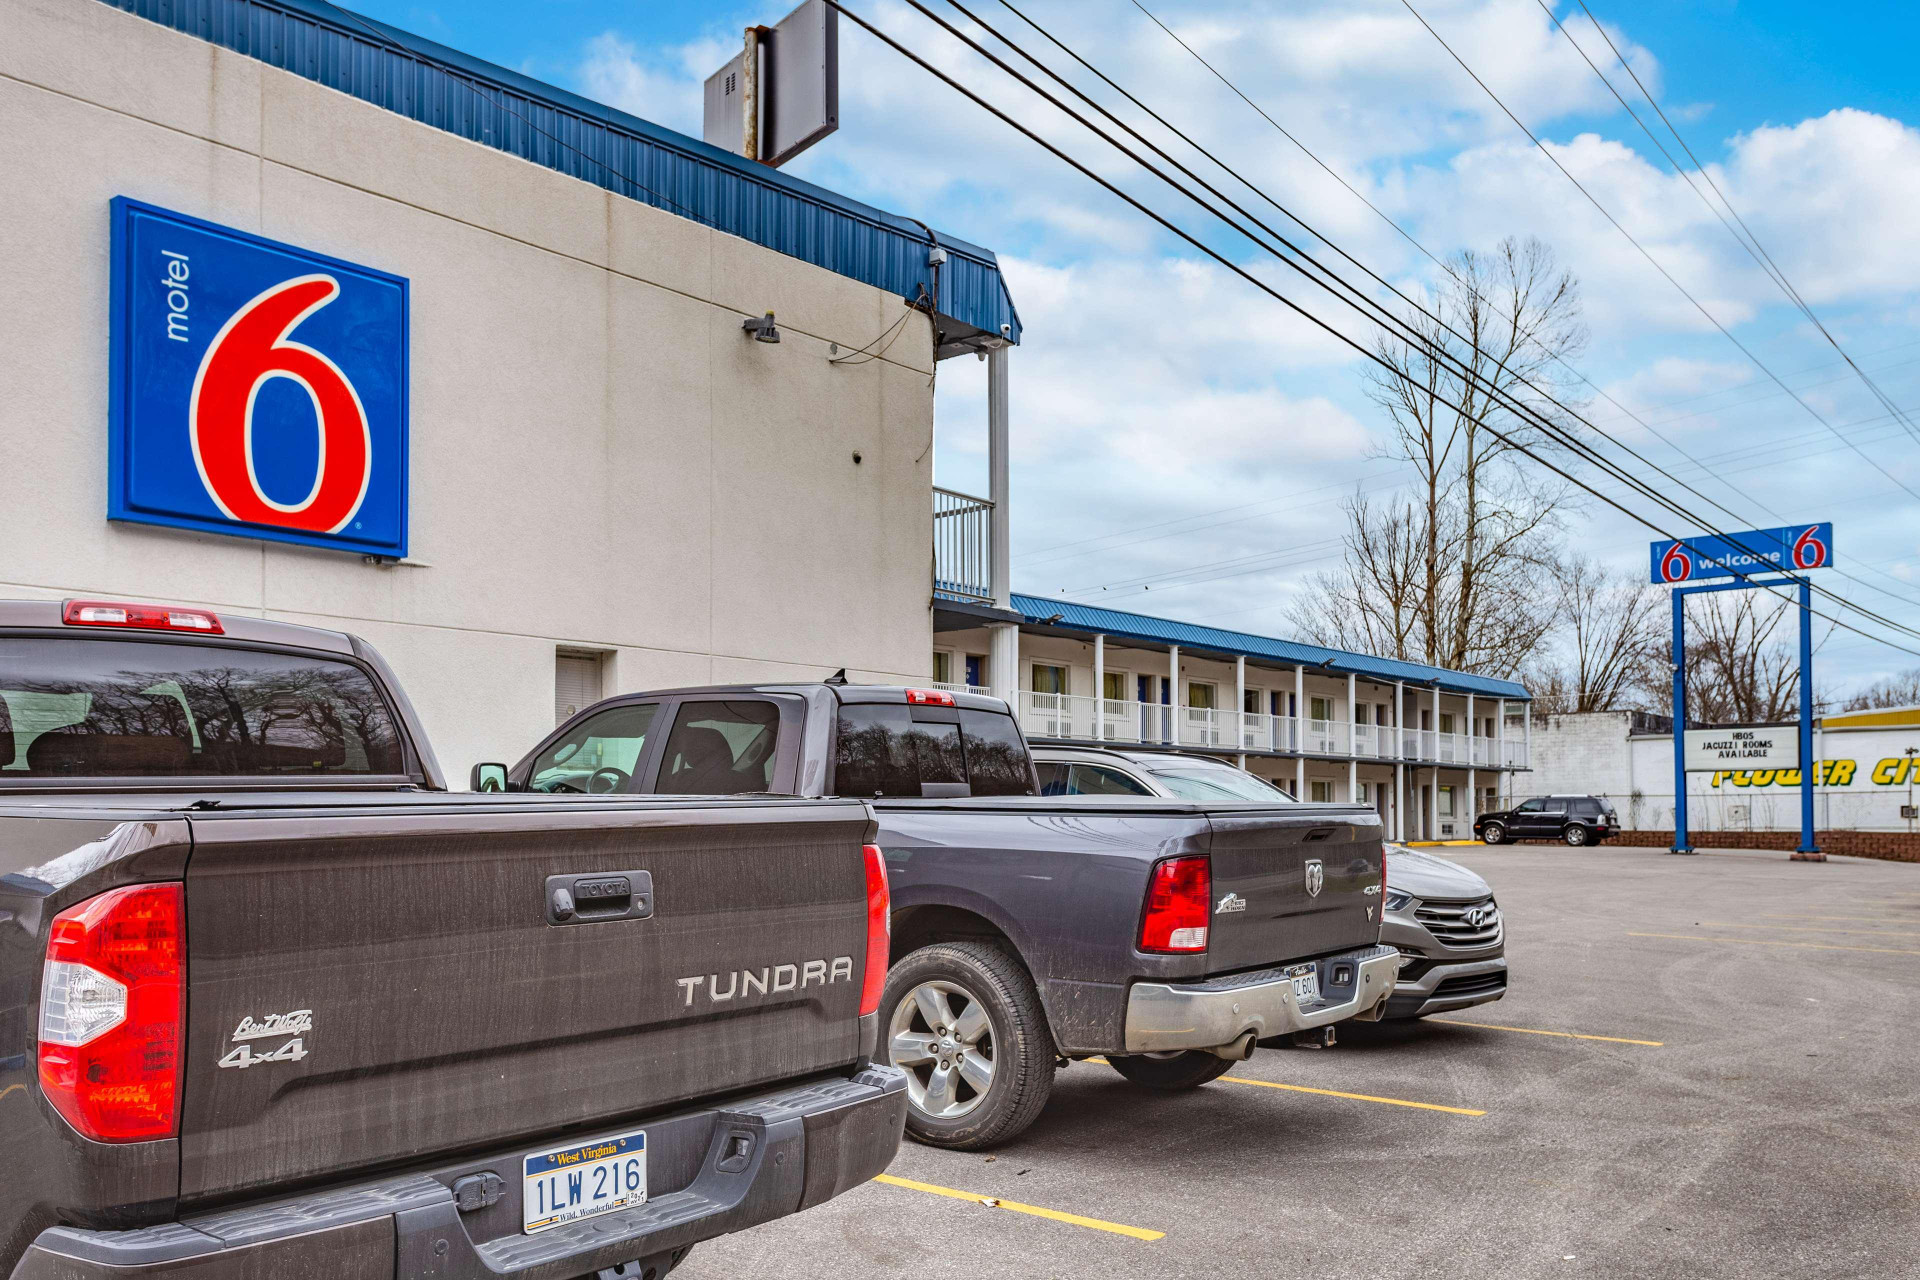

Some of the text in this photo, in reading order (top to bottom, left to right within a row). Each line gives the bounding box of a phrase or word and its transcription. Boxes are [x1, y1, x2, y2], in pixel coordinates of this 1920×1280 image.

[161, 249, 190, 343] motel
[189, 273, 372, 534] 6
[1661, 540, 1692, 583] 6
[1698, 551, 1781, 570] welcome
[1792, 525, 1827, 569] 6
[1702, 740, 1773, 750] JACUZZI ROOMS
[1718, 749, 1768, 758] AVAILABLE
[581, 881, 629, 897] TOYOTA
[676, 956, 852, 1006] TUNDRA
[557, 1143, 617, 1165] West Virginia
[537, 1158, 640, 1214] 1LW 216
[579, 1201, 615, 1216] Wonderful
